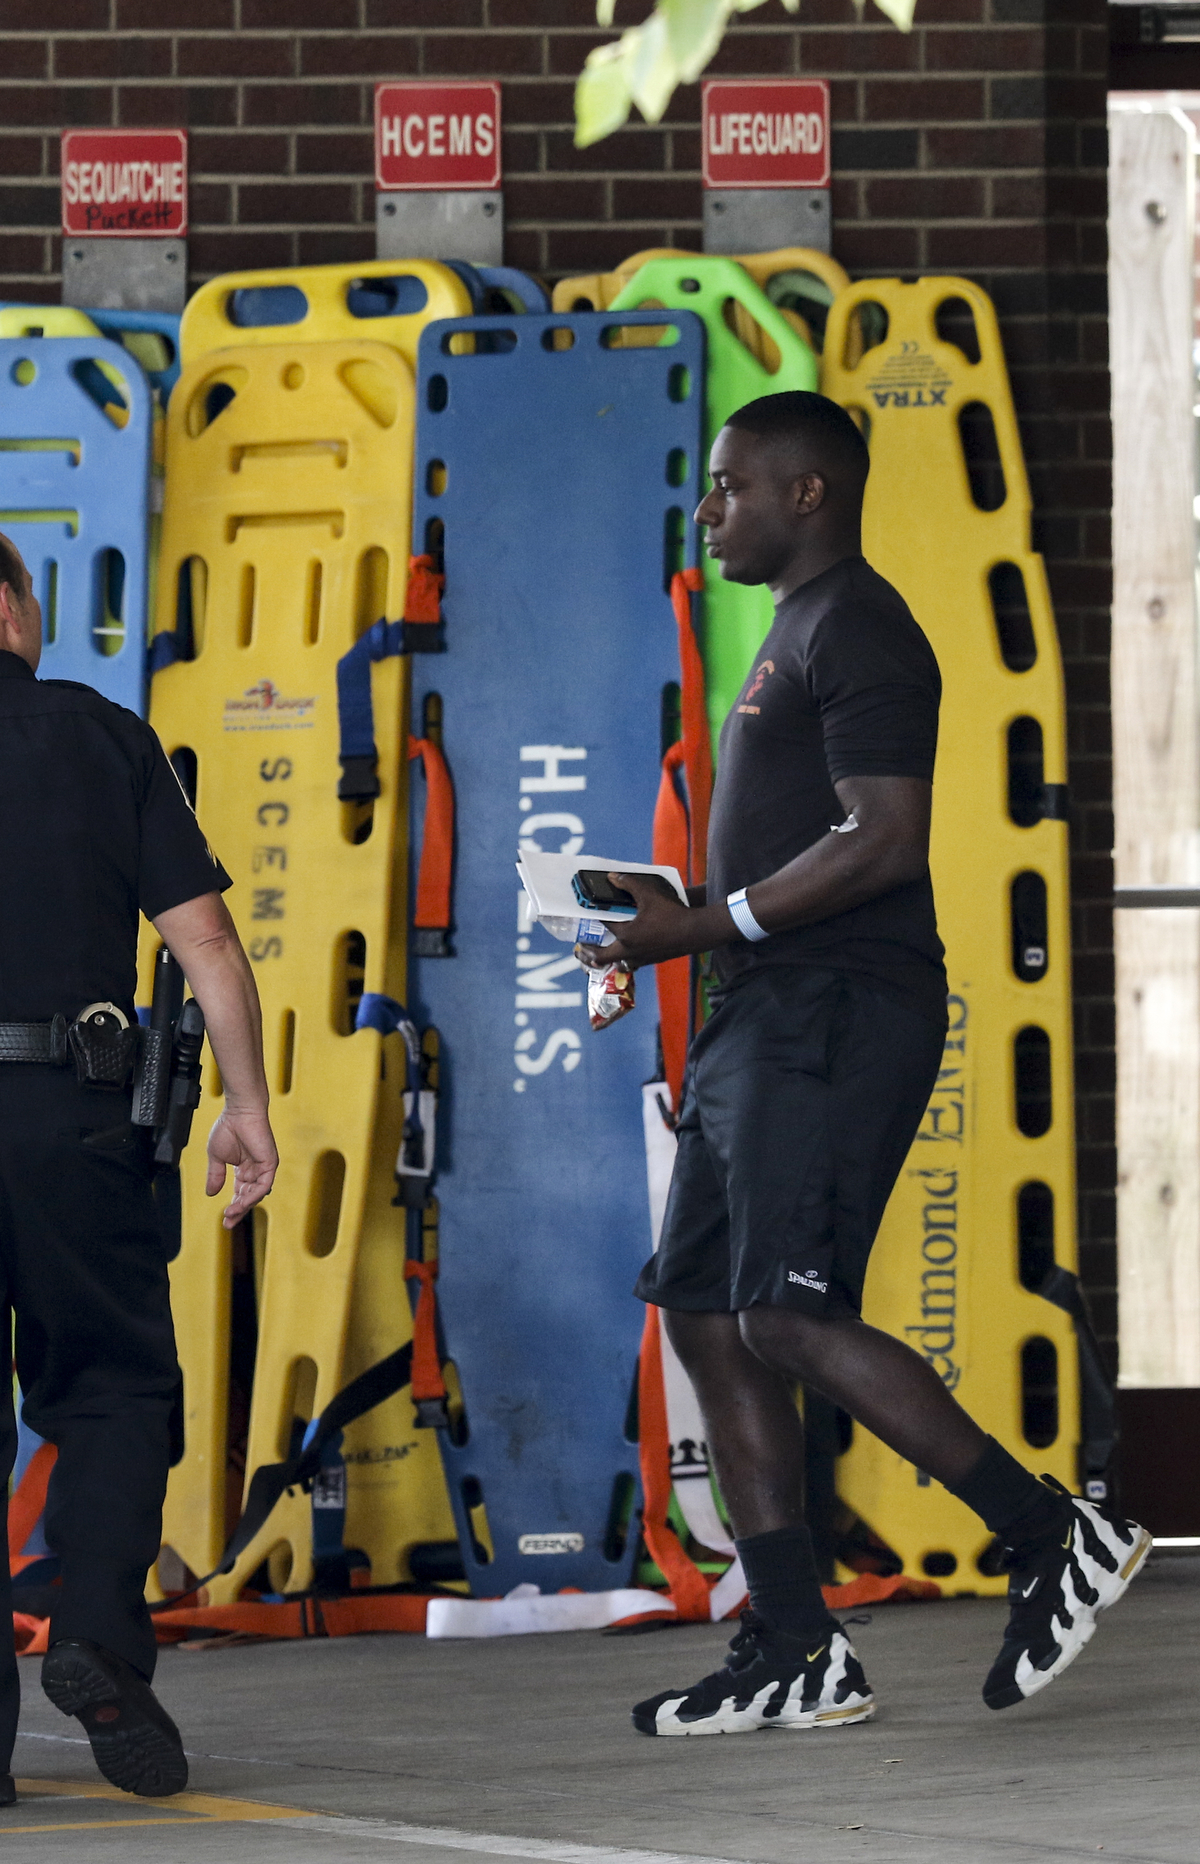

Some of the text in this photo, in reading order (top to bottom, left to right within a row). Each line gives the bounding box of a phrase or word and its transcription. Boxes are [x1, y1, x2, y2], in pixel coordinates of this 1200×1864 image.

[381, 114, 494, 157] HCEMS
[709, 113, 824, 156] LIFEGUARD
[66, 161, 183, 204] SEQUATCHIE
[86, 201, 172, 230] Puckett
[873, 390, 947, 408] XTRA
[787, 1270, 828, 1294] SPALDING
